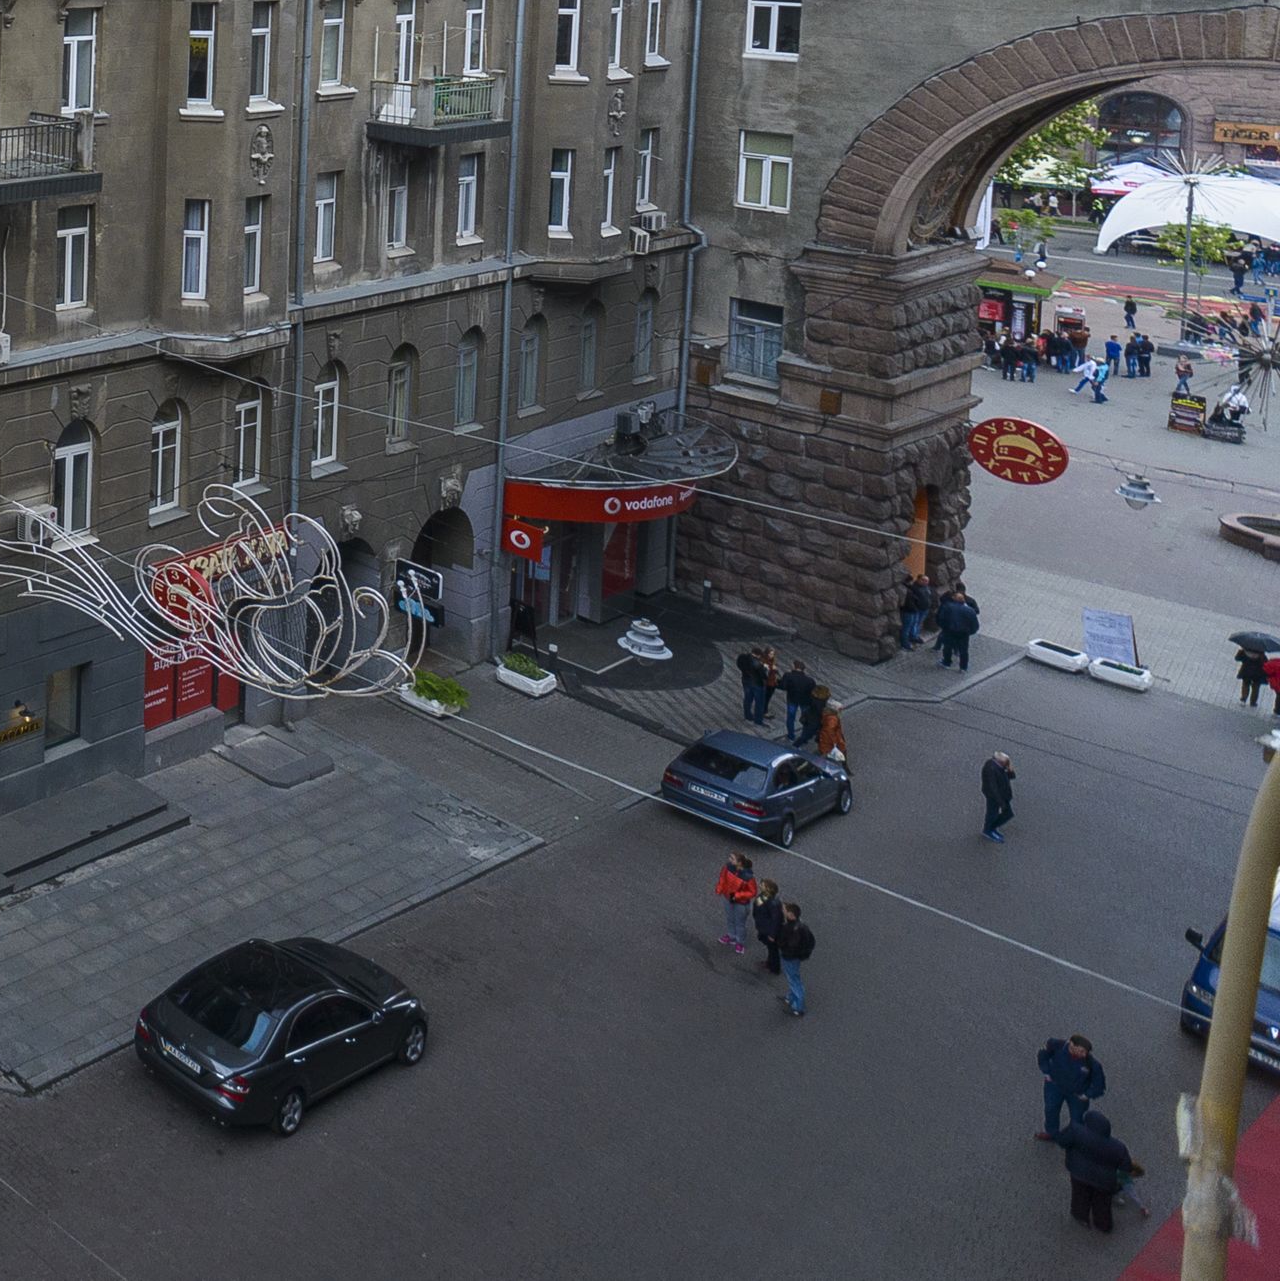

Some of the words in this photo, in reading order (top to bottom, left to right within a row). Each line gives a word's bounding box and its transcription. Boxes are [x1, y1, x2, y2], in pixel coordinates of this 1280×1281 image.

[973, 421, 1062, 462] ПУЗАТА
[983, 458, 1050, 482] ХАТА
[625, 495, 673, 510] vodafone
